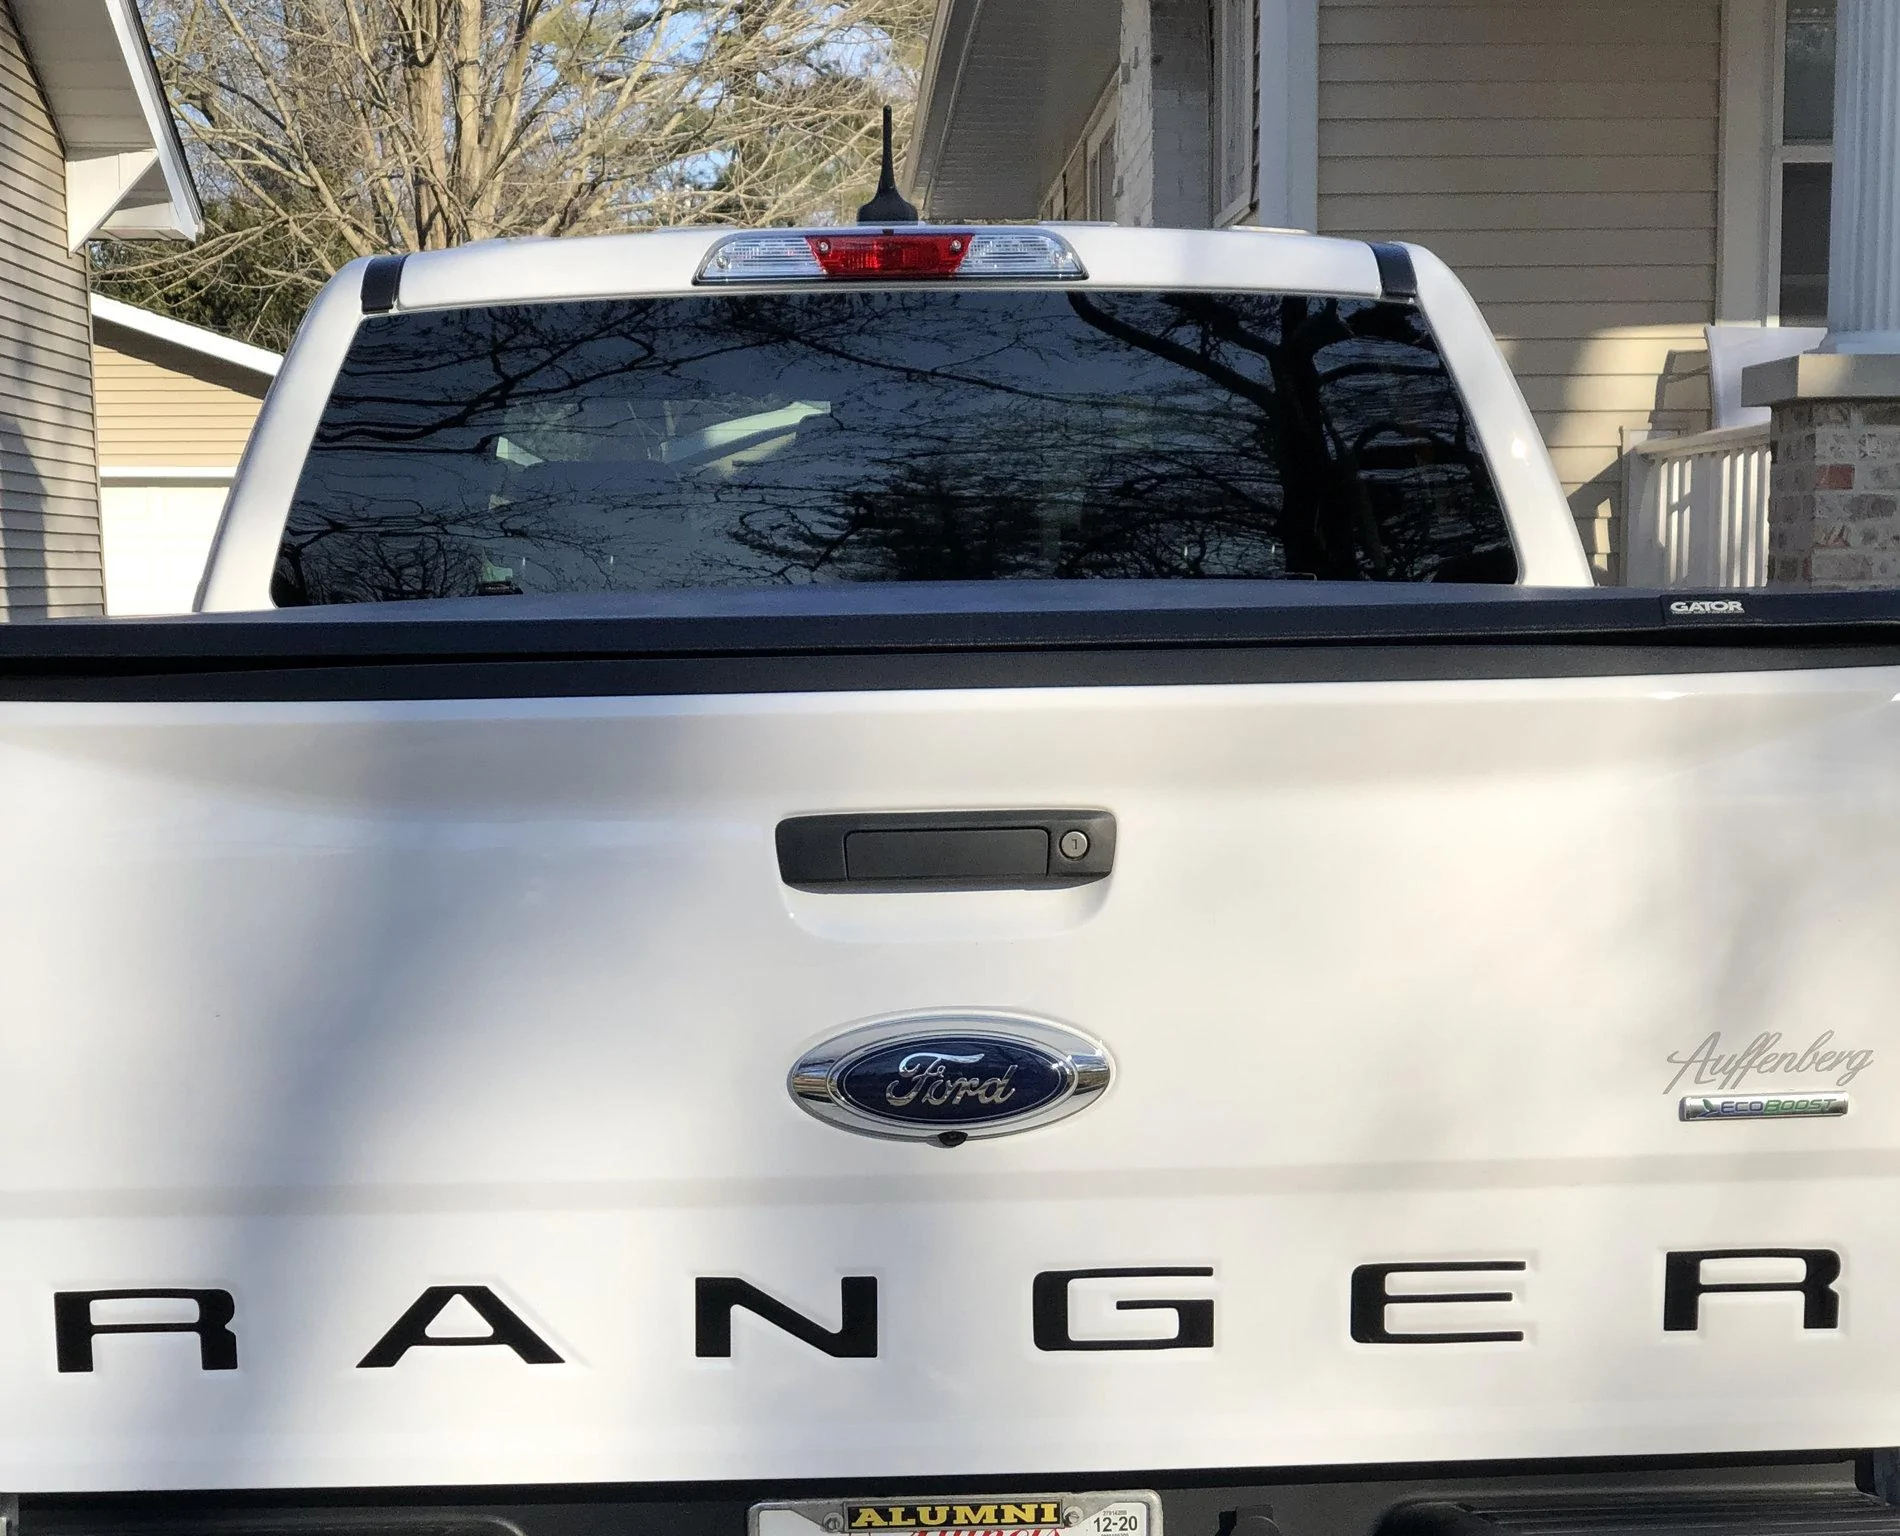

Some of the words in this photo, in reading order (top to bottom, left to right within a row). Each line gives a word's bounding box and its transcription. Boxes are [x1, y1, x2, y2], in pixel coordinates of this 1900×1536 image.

[1670, 601, 1744, 612] GATOR
[1663, 1030, 1874, 1094] Auffenberg
[886, 1052, 1019, 1105] Ford
[1719, 1098, 1836, 1114] ECOBOOST
[55, 1248, 1841, 1373] RANGER
[851, 1503, 1058, 1527] ALUMNI
[1093, 1515, 1138, 1533] 12-20
